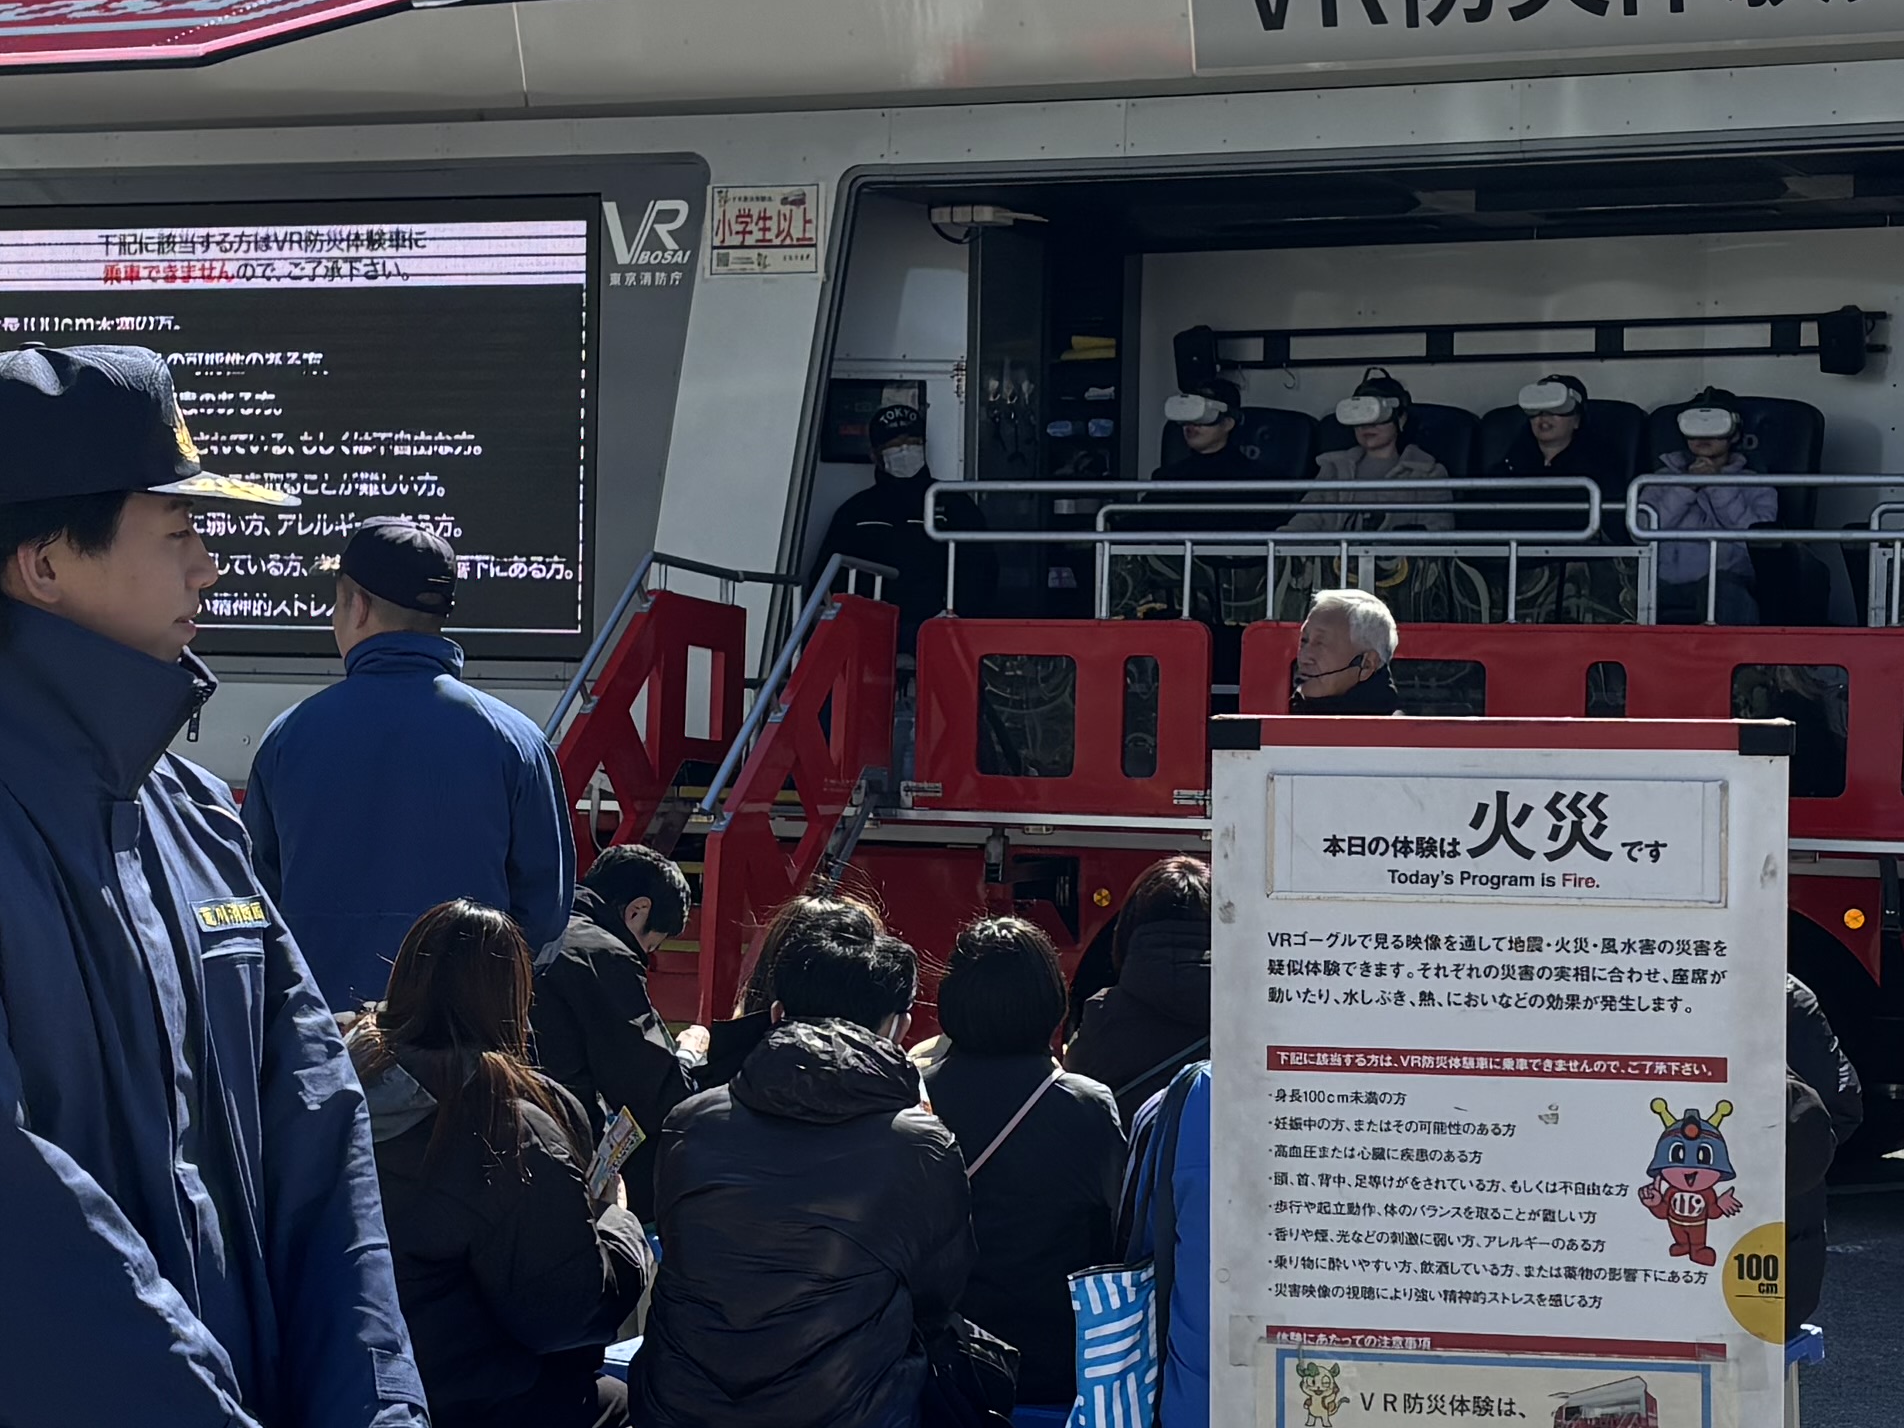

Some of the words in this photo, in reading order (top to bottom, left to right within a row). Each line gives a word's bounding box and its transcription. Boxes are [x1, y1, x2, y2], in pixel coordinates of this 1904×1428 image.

[603, 200, 689, 265] VR
[715, 207, 814, 245] 小学生以上
[638, 249, 691, 265] BOSAI
[880, 408, 917, 424] TOKYO
[1322, 834, 1462, 860] 本日の体験は
[1466, 789, 1613, 863] 火災
[1620, 840, 1668, 864] です
[1387, 868, 1454, 888] Today's
[1459, 870, 1534, 891] Program
[1541, 871, 1554, 887] is
[1561, 872, 1601, 889] Fire.
[1267, 987, 1695, 1014] 動いたり、水しぶき、熱、においなどの効果が発生します。
[1734, 1254, 1779, 1283] 100
[1757, 1281, 1779, 1295] cm
[1359, 1390, 1527, 1420] VR防災体験は、
